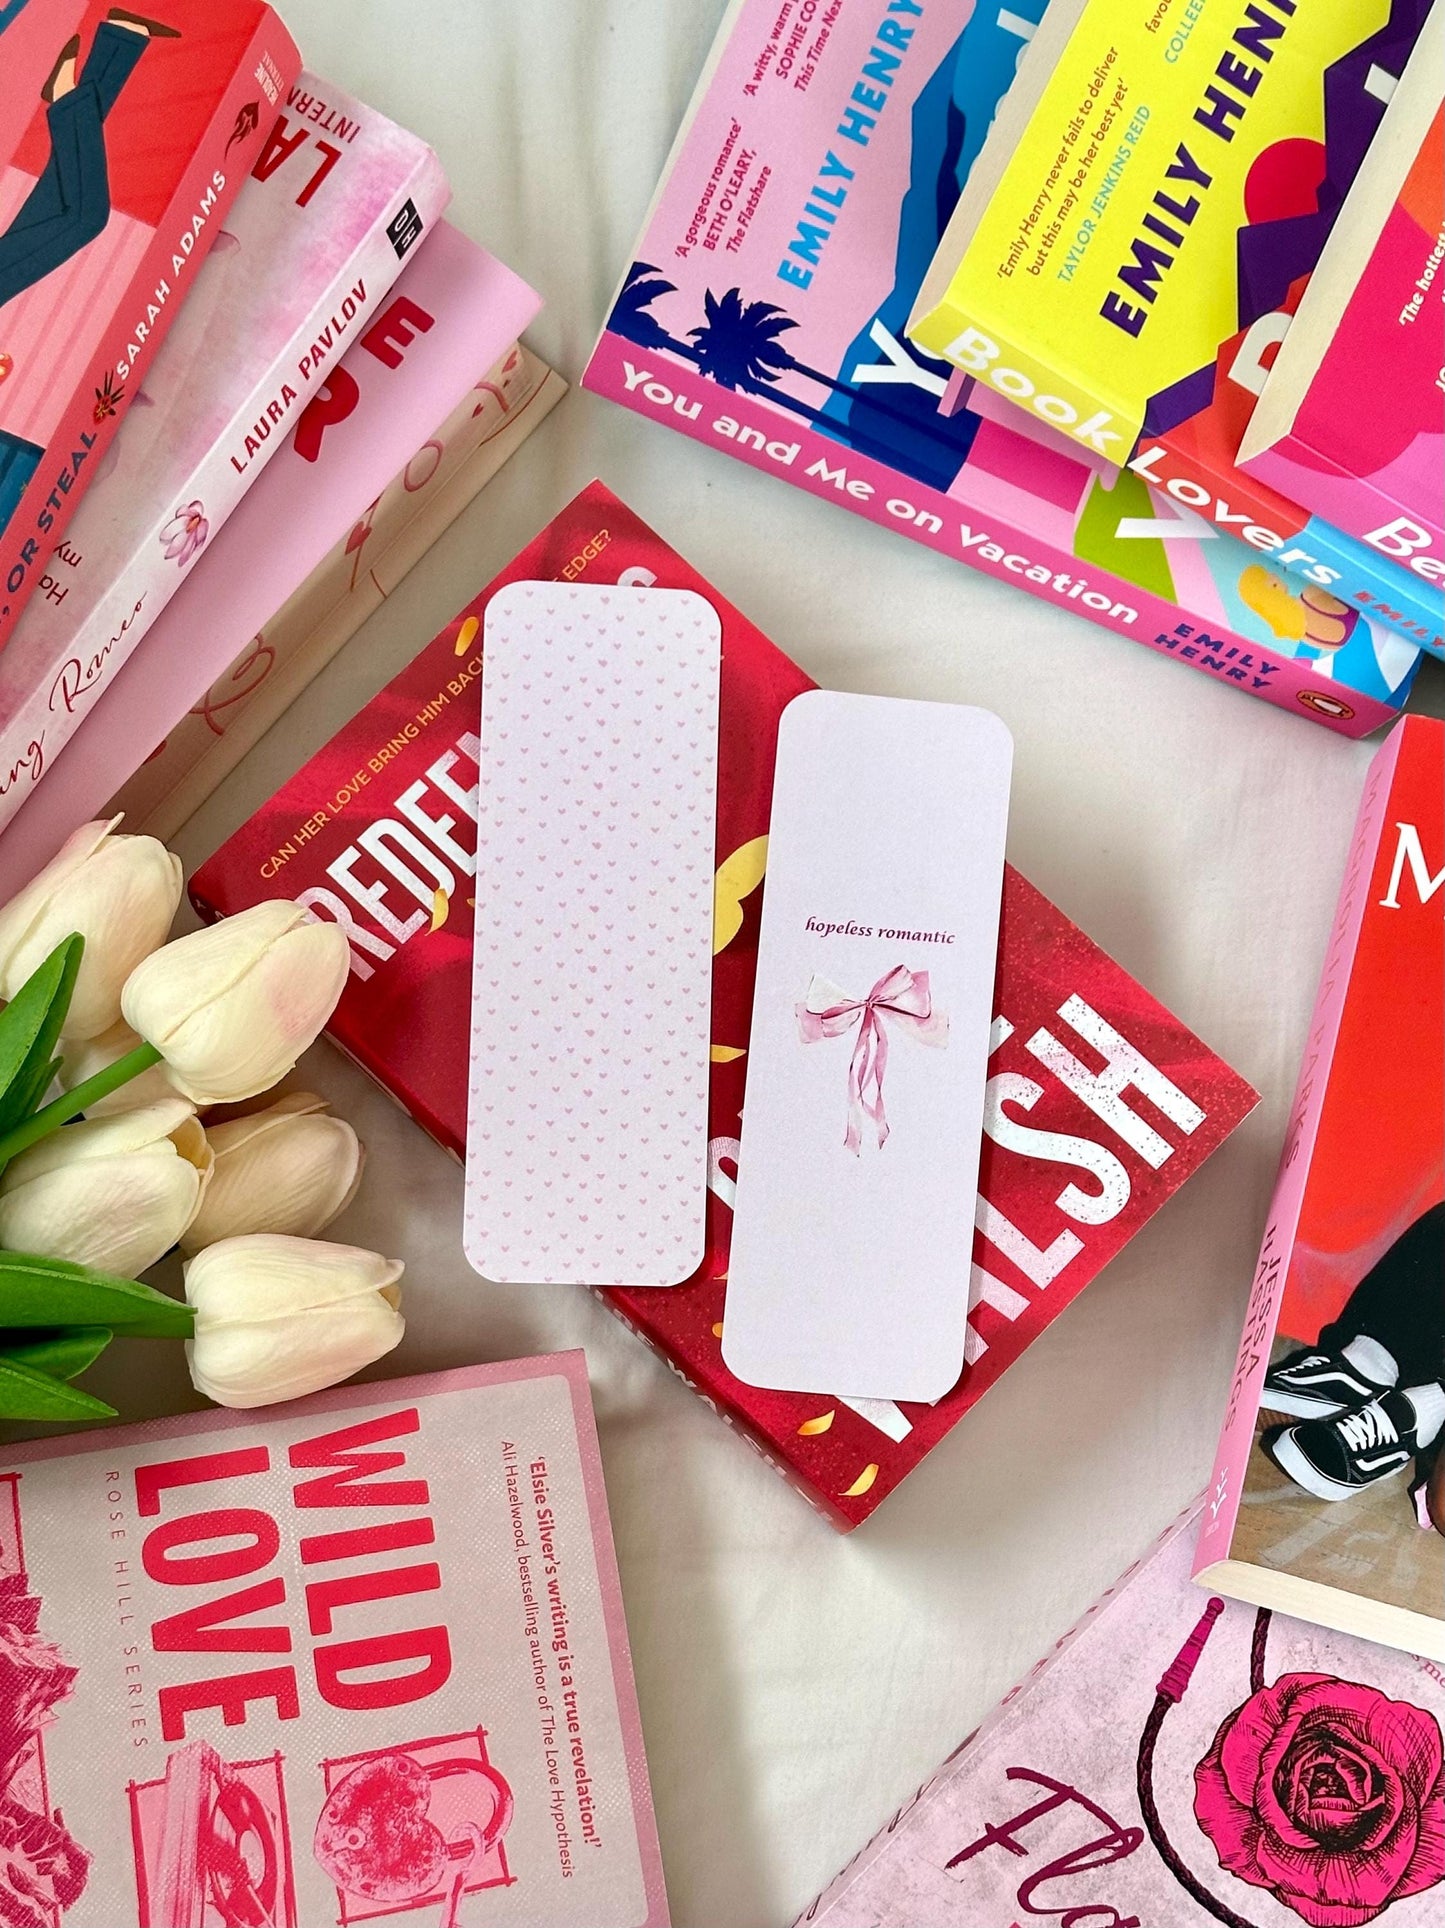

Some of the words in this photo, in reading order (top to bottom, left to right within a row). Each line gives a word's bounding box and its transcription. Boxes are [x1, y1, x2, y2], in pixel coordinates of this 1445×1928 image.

[753, 44, 779, 82] witty,
[770, 2, 793, 41] warm
[776, 24, 808, 80] SOPHIE
[799, 0, 820, 23] CO
[794, 65, 815, 92] This
[807, 28, 830, 62] Time
[685, 181, 717, 246] gorgeous
[710, 117, 741, 182] romance'
[702, 212, 728, 251] BETH
[719, 148, 758, 212] O'LEARY,
[997, 235, 1030, 279] 'Emily
[1019, 189, 1053, 236] Henry
[1046, 148, 1070, 189] never
[1062, 120, 1085, 148] fails
[1078, 99, 1093, 117] to
[1088, 46, 1119, 98] deliver
[1026, 249, 1048, 276] but
[1041, 222, 1062, 254] this
[1057, 189, 1080, 221] may
[1069, 168, 1087, 189] be
[1081, 142, 1100, 169] her
[1091, 107, 1117, 141] best
[1110, 77, 1128, 112] yet'
[1057, 217, 1097, 284] TAYLOR
[1091, 146, 1131, 218] JENKINS
[1124, 104, 1151, 146] REID
[1099, 142, 1213, 338] EMILY
[1193, 0, 1297, 143] HEN
[725, 228, 746, 253] The
[737, 165, 772, 227] Flatshare
[776, 150, 855, 291] EMILY
[116, 279, 171, 380] SARAH
[171, 170, 226, 277] ADAMS
[230, 384, 298, 475] LAURA
[298, 278, 367, 380] PAVLOV
[622, 361, 704, 421] You
[712, 414, 801, 466] and
[804, 458, 875, 500] Me
[885, 498, 943, 534] on
[960, 523, 1139, 624] Vacation
[942, 326, 1122, 454] Book
[1127, 446, 1343, 585] Lovers
[7, 537, 40, 593] OR
[37, 432, 97, 534] STEAL
[1362, 516, 1445, 589] Be
[49, 591, 147, 713] Romeo
[1154, 633, 1272, 689] HENRY
[1173, 623, 1281, 675] EMILY
[260, 842, 297, 879] CAN
[293, 811, 331, 847] HER
[327, 770, 372, 814] LOVE
[367, 722, 420, 774] BRING
[416, 692, 451, 726] HIM
[447, 652, 483, 697] BAC
[562, 528, 612, 580] EDGE?
[805, 916, 873, 938] hopeless
[878, 926, 956, 944] romantic
[1224, 1224, 1278, 1432] HASTINGS
[1246, 1256, 1281, 1381] JESSA
[501, 1441, 518, 1461] Ali
[105, 1471, 126, 1541] ROSE
[504, 1464, 530, 1552] Hazelwood,
[537, 1508, 561, 1575] Silver's
[114, 1560, 132, 1626] HILL
[134, 1445, 301, 1742] LOVE
[288, 1407, 452, 1711] WILD
[517, 1554, 540, 1637] bestselling
[547, 1578, 570, 1652] writing
[124, 1646, 148, 1748] SERIES
[530, 1640, 547, 1692] author
[538, 1696, 554, 1711] of
[558, 1655, 575, 1670] is
[561, 1675, 574, 1687] a
[541, 1715, 556, 1745] The
[563, 1690, 580, 1733] true
[545, 1750, 560, 1785] Love
[550, 1790, 575, 1879] Hypothesis
